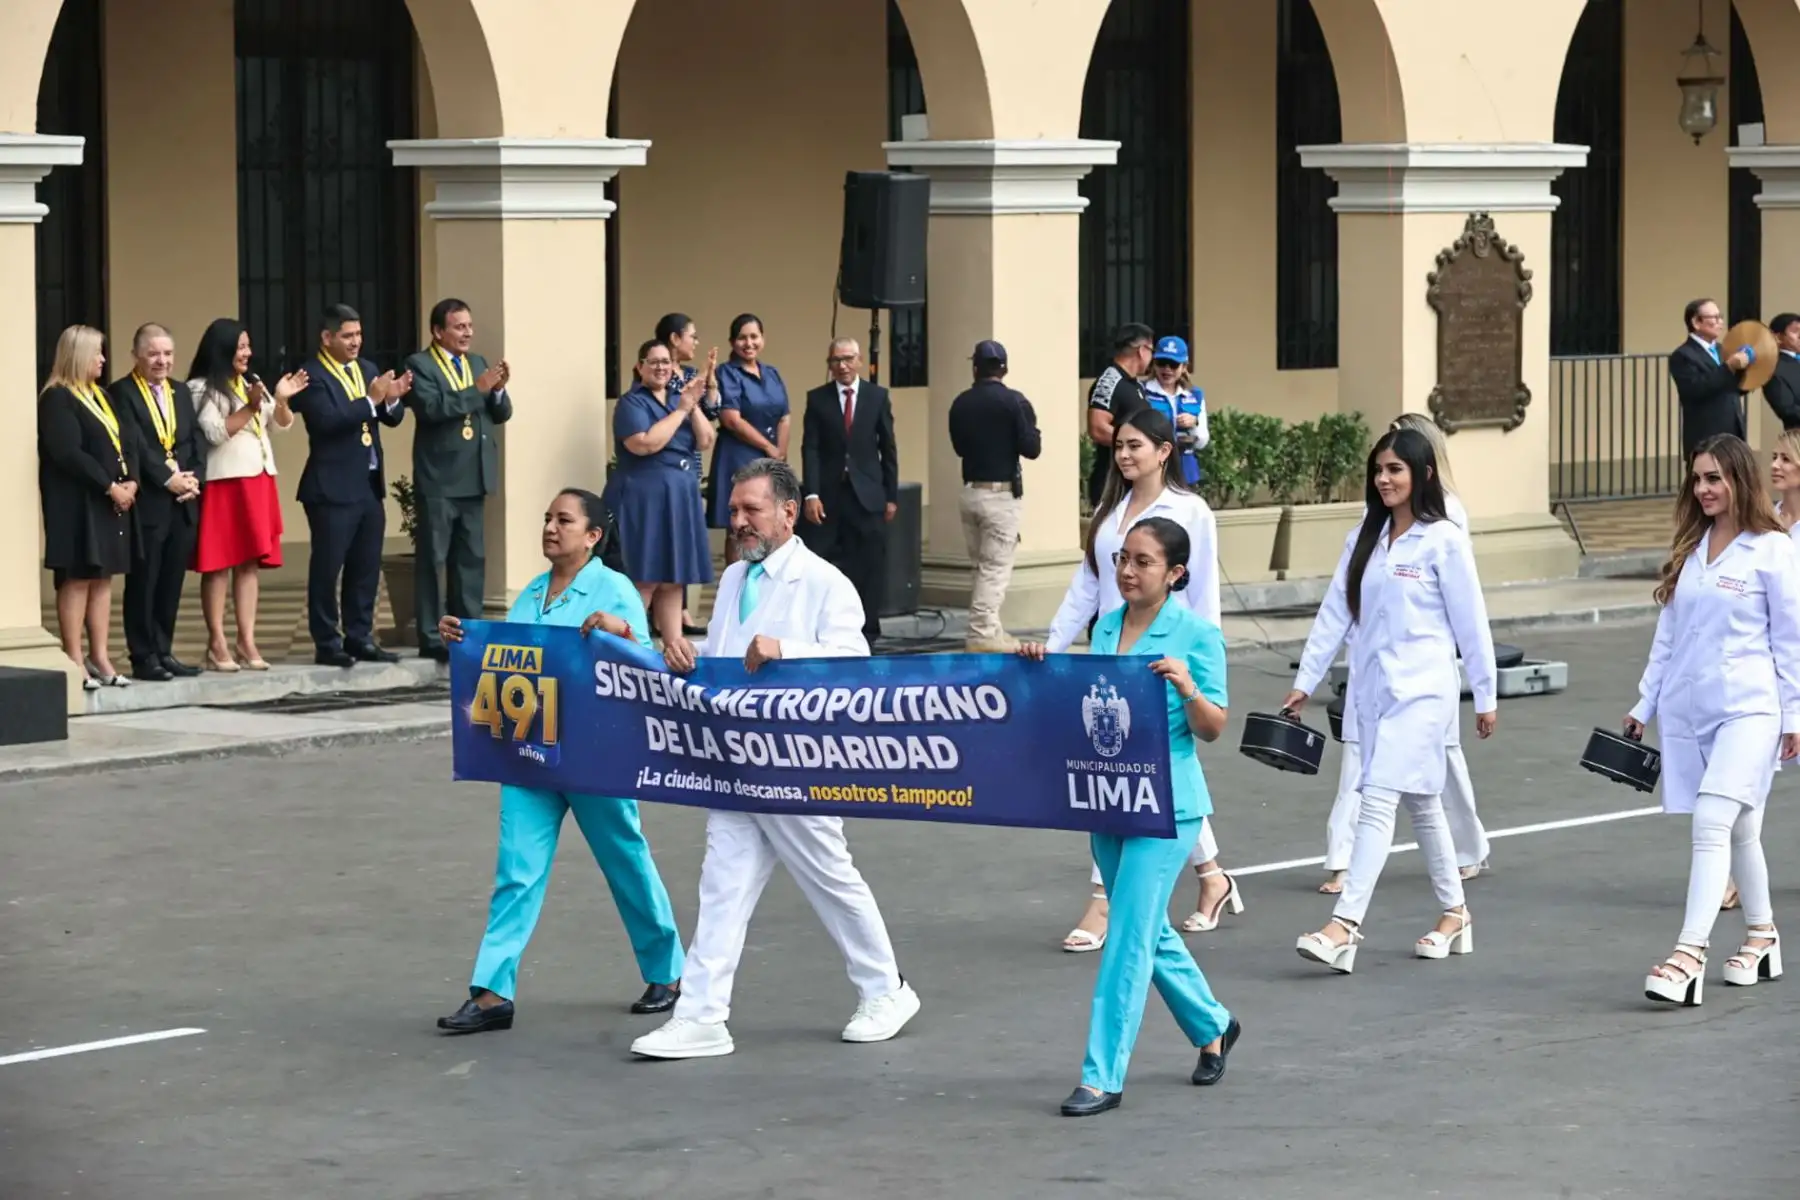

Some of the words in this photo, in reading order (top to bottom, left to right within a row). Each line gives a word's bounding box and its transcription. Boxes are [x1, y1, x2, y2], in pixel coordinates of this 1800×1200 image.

[487, 647, 538, 670] LIMA
[470, 671, 559, 745] 491
[595, 660, 708, 713] SISTEMA
[710, 685, 1008, 722] METROPOLITANO
[518, 744, 546, 763] años
[645, 716, 683, 753] DE
[684, 722, 723, 762] LA
[729, 731, 959, 770] SOLIDARIDAD
[636, 766, 661, 788] ¡La
[664, 768, 711, 792] ciudad
[714, 777, 731, 794] no
[733, 779, 807, 802] descansa,
[808, 784, 887, 803] nosotros
[892, 783, 973, 809] tampoco!
[1066, 759, 1141, 774] MUNICIPALIDAD
[1144, 763, 1156, 774] DE
[1067, 773, 1160, 814] LIMA
